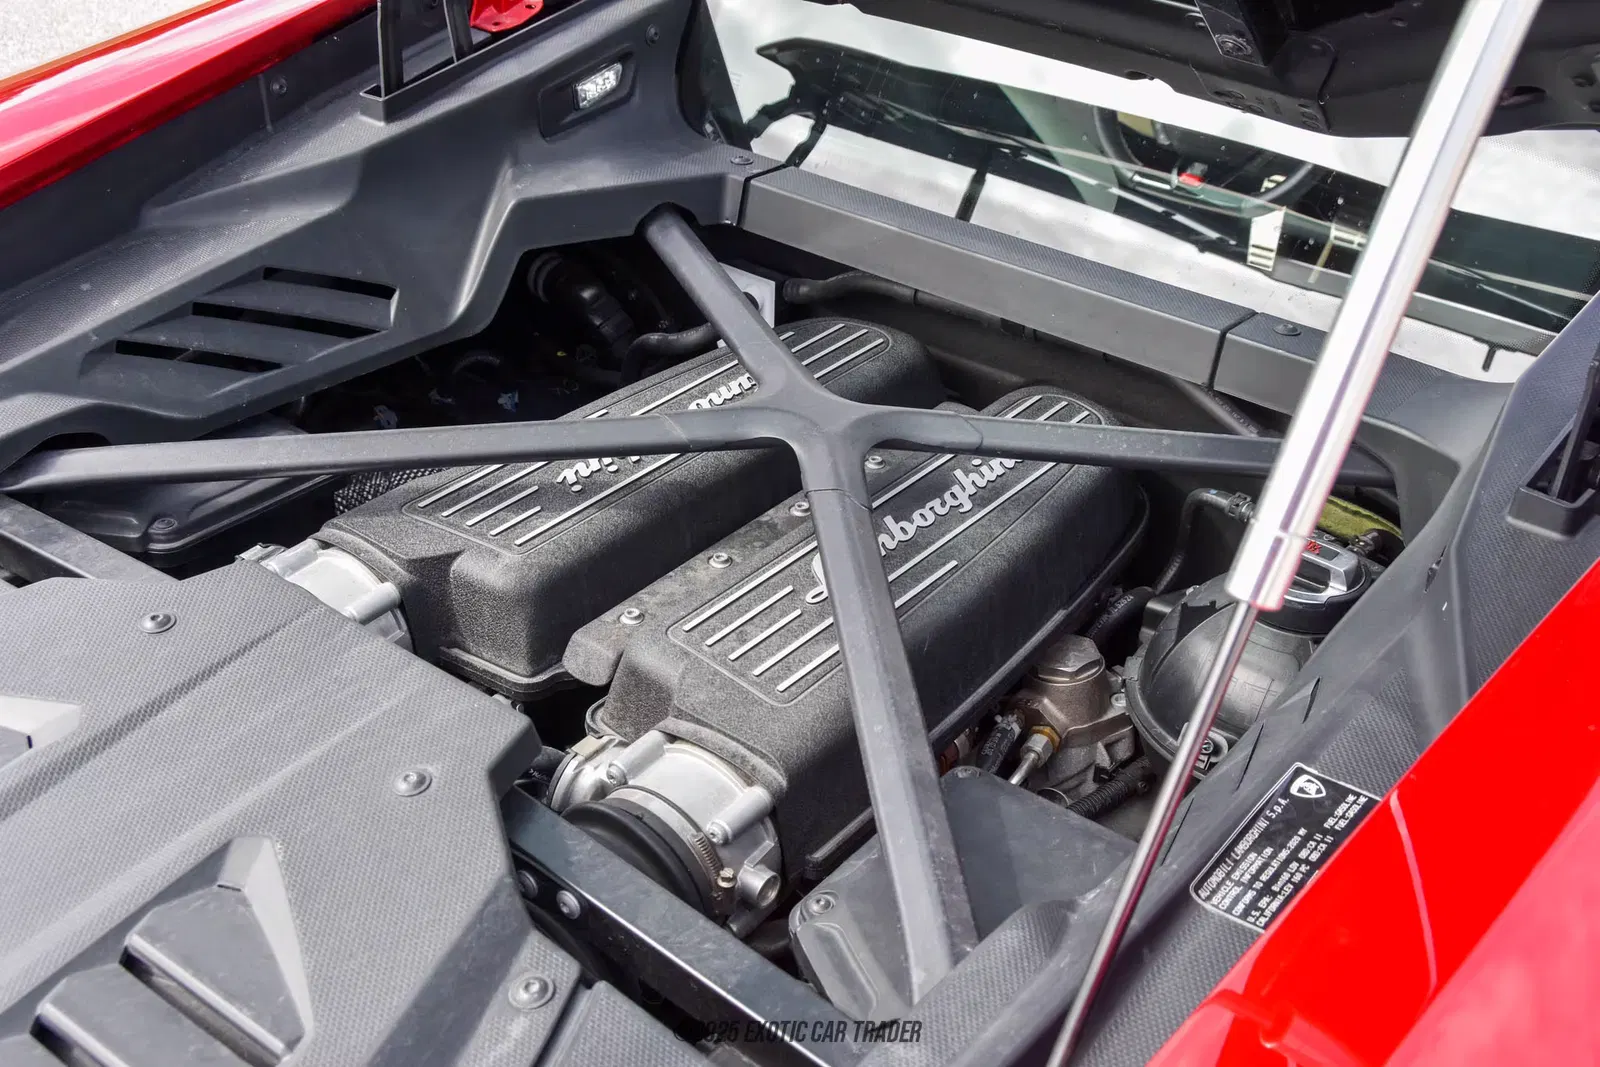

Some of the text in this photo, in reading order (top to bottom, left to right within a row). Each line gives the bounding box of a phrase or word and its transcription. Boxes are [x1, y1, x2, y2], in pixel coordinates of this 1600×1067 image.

[1198, 797, 1290, 900] AUTOMOBILI LAMBORGHINI S.p.A.
[1210, 851, 1258, 906] VEHICLE EMISSION
[1218, 846, 1274, 911] CONTROL INFORMATION
[1232, 888, 1257, 917] CONFORMS
[1253, 880, 1264, 892] TO
[1247, 905, 1262, 923] U.S.
[1257, 894, 1273, 909] EPA:
